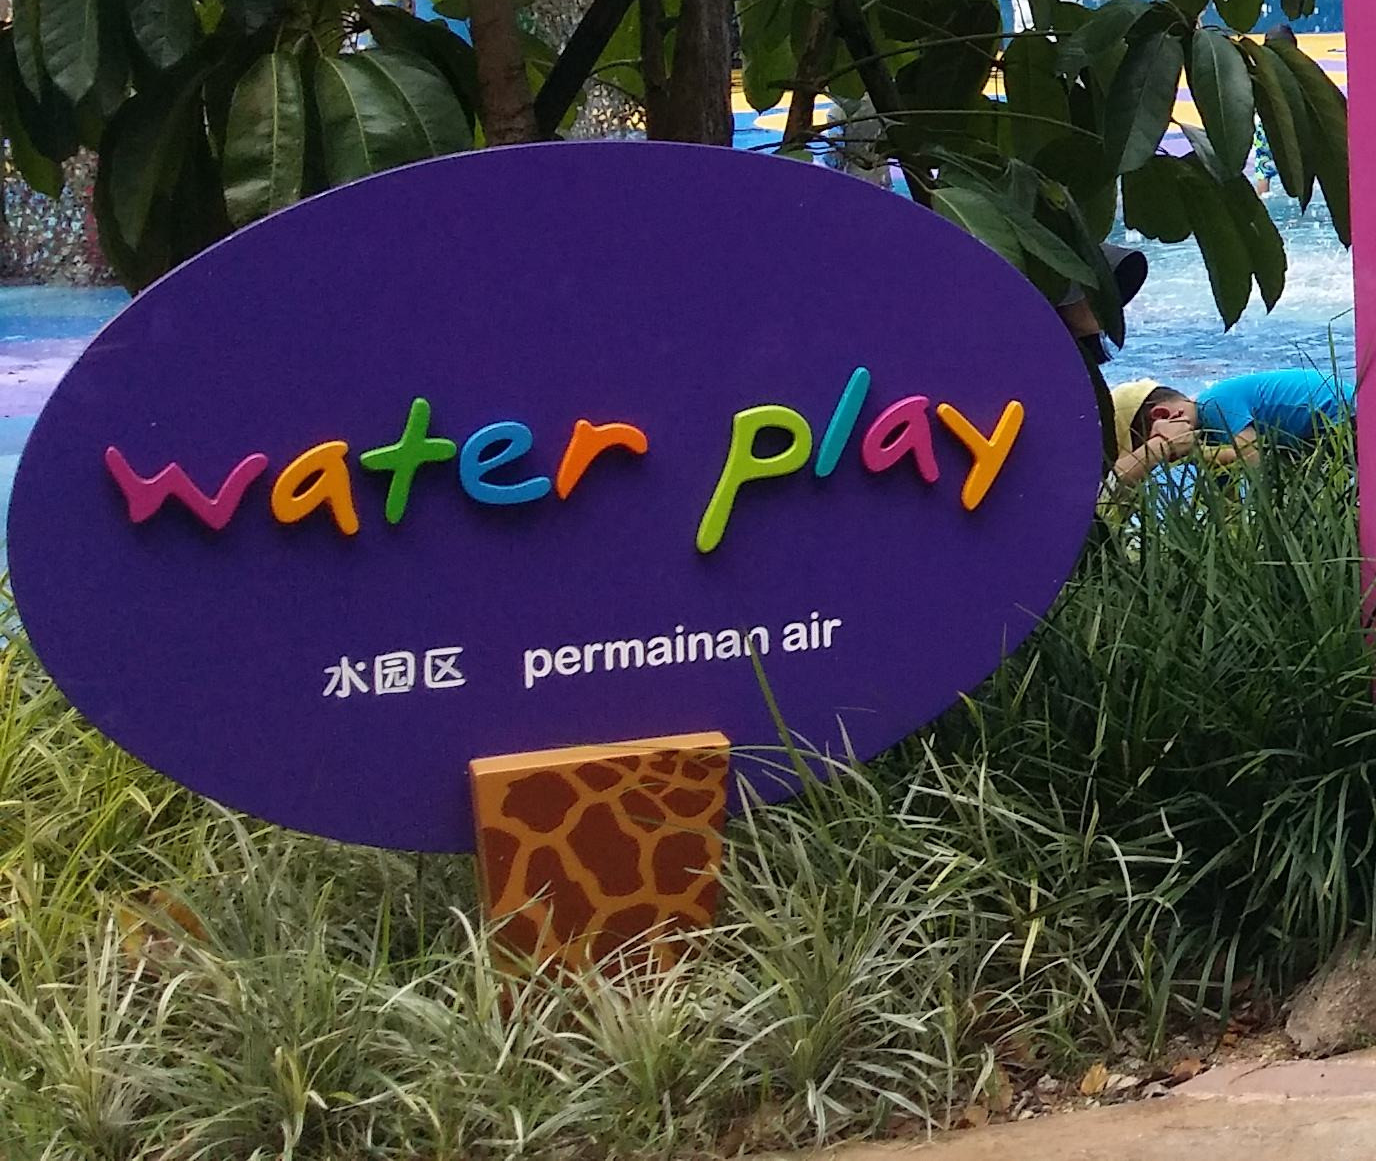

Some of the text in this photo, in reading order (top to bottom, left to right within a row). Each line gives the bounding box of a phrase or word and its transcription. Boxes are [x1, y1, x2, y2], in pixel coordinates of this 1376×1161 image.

[103, 366, 1026, 554] water play
[322, 645, 466, 698] 水园区
[523, 611, 842, 689] permainan air
